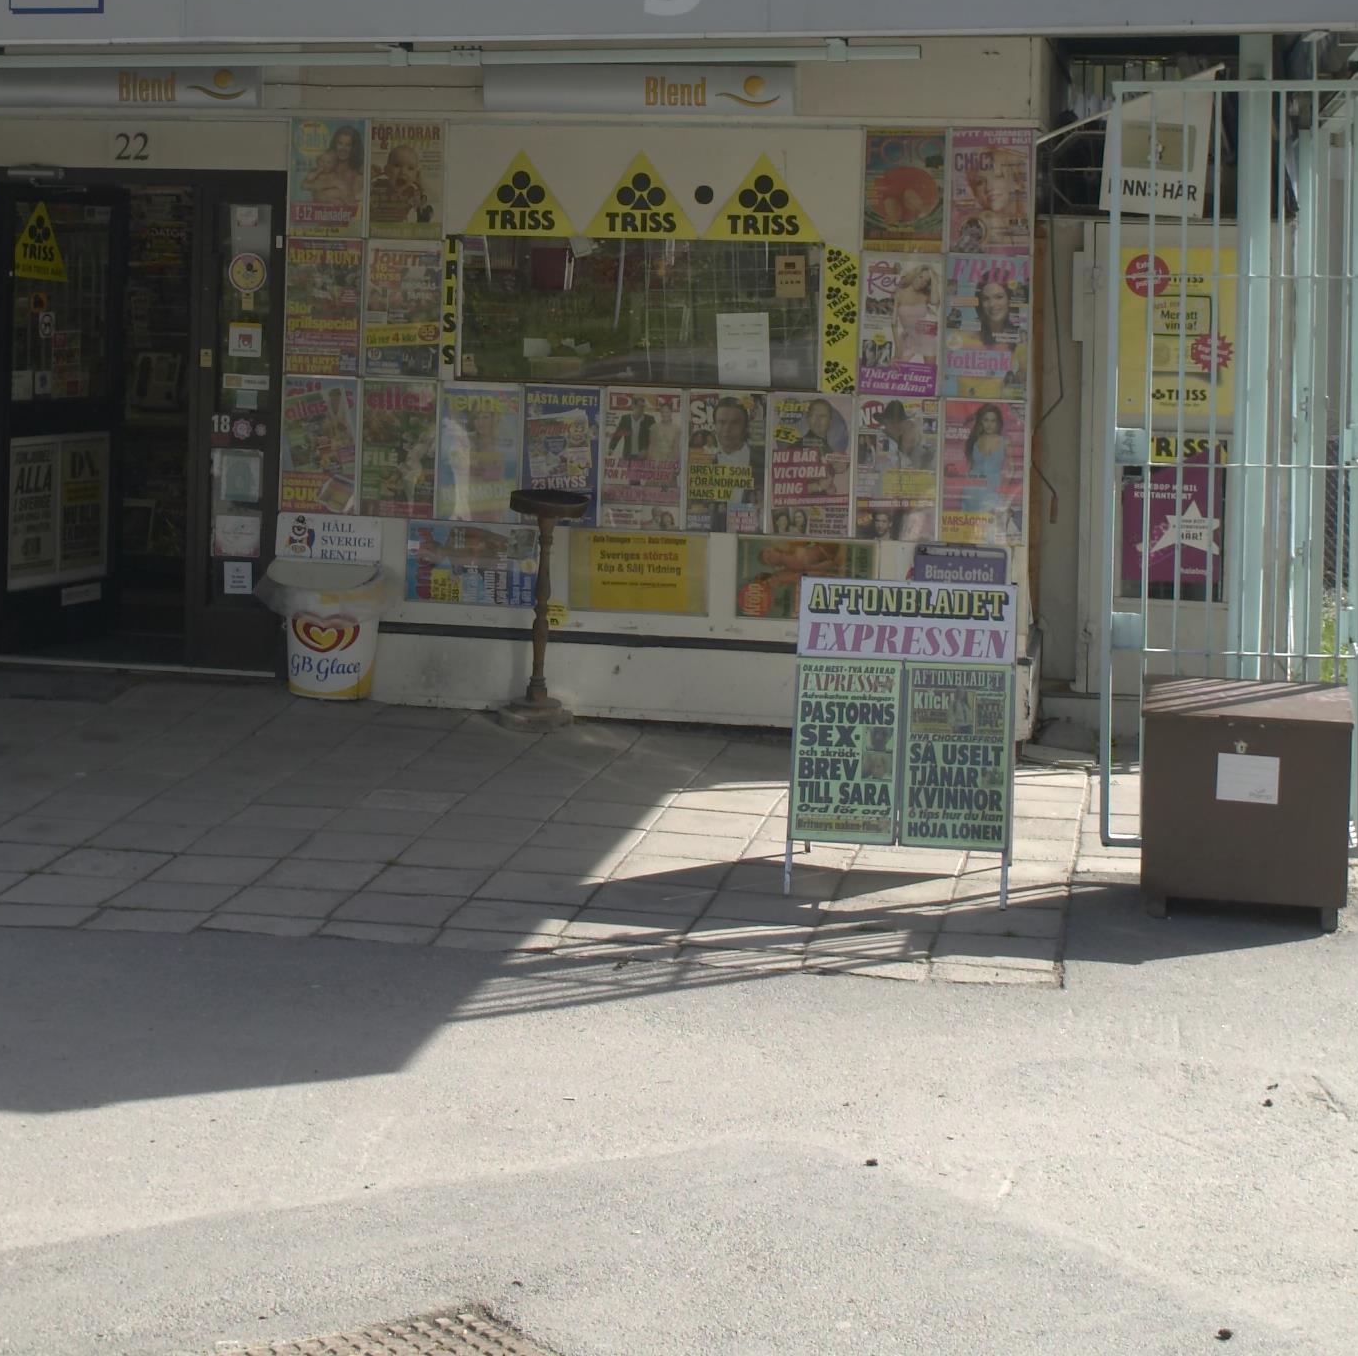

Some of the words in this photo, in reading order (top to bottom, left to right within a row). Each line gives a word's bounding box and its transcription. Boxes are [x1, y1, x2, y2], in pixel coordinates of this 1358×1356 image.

[118, 70, 177, 101] Blend
[644, 75, 707, 107] Blend
[372, 124, 441, 141] FÖRÄLDRAR
[115, 132, 150, 161] 22
[1163, 181, 1197, 201] HÄR
[486, 209, 556, 231] TRISS
[606, 212, 677, 234] TRISS
[727, 214, 800, 236] TRISS
[23, 243, 54, 263] TRISS
[326, 248, 360, 266] RUNT
[828, 255, 851, 273] TRISS
[827, 292, 850, 310] TRISS
[1164, 321, 1198, 332] vina!
[826, 329, 849, 347] TRISS
[825, 366, 848, 384] TRISS
[526, 391, 560, 405] BÄSTA
[562, 392, 598, 407] KÖPET!
[1166, 388, 1207, 401] TISS
[212, 414, 230, 432] 18
[773, 451, 790, 463] NU
[793, 448, 817, 463] BÄR
[1151, 437, 1209, 458] RISS
[690, 464, 726, 476] BREVET
[729, 466, 751, 477] SOM
[773, 466, 827, 479] VICTORIA
[14, 465, 52, 495] ALLA
[531, 477, 547, 489] 23
[548, 475, 587, 488] KRYSS
[689, 476, 754, 489] FÖRÄNDRADE
[774, 481, 803, 495] RING
[689, 489, 715, 500] HANS
[717, 489, 733, 500] LIV
[321, 518, 355, 533] HÅLL
[321, 535, 375, 549] SVERIGE
[320, 548, 358, 561] RENT!
[600, 550, 641, 563] Sveriges
[643, 551, 679, 562] största
[597, 563, 615, 575] Köp
[617, 563, 624, 574] &
[626, 563, 644, 576] Sälj
[647, 563, 682, 576] Tidning
[925, 564, 994, 582] BingoLotto!
[808, 583, 1010, 622] AFTONBLADET
[806, 620, 1010, 659] EXPRESSEN
[291, 653, 314, 676] GB
[316, 657, 362, 682] Glace
[803, 672, 895, 693] EXPRESSEN
[913, 669, 1003, 689] AFTONBLADET
[914, 690, 952, 710] Klick!
[801, 700, 895, 725] PASTORNS
[800, 724, 861, 747] SEX-
[909, 733, 930, 742] NYA
[932, 733, 1004, 744] CHOCKSIFFROR
[799, 748, 818, 757] och
[909, 740, 937, 766] SÅ
[942, 744, 1004, 767] USELT
[798, 757, 860, 781] BREV
[909, 763, 979, 788] TJÄNAR
[797, 780, 833, 803] TILL
[839, 782, 891, 806] SARA
[908, 786, 1003, 812] KVINNOR
[797, 803, 829, 813] Ord
[833, 804, 857, 815] för
[861, 806, 891, 816] ord
[908, 808, 916, 818] 6
[918, 808, 940, 821] tips
[943, 809, 961, 820] hur
[964, 810, 978, 821] du
[980, 811, 1003, 822] kan
[907, 819, 948, 838] HÖJA
[951, 820, 1003, 842] LÖNEN
